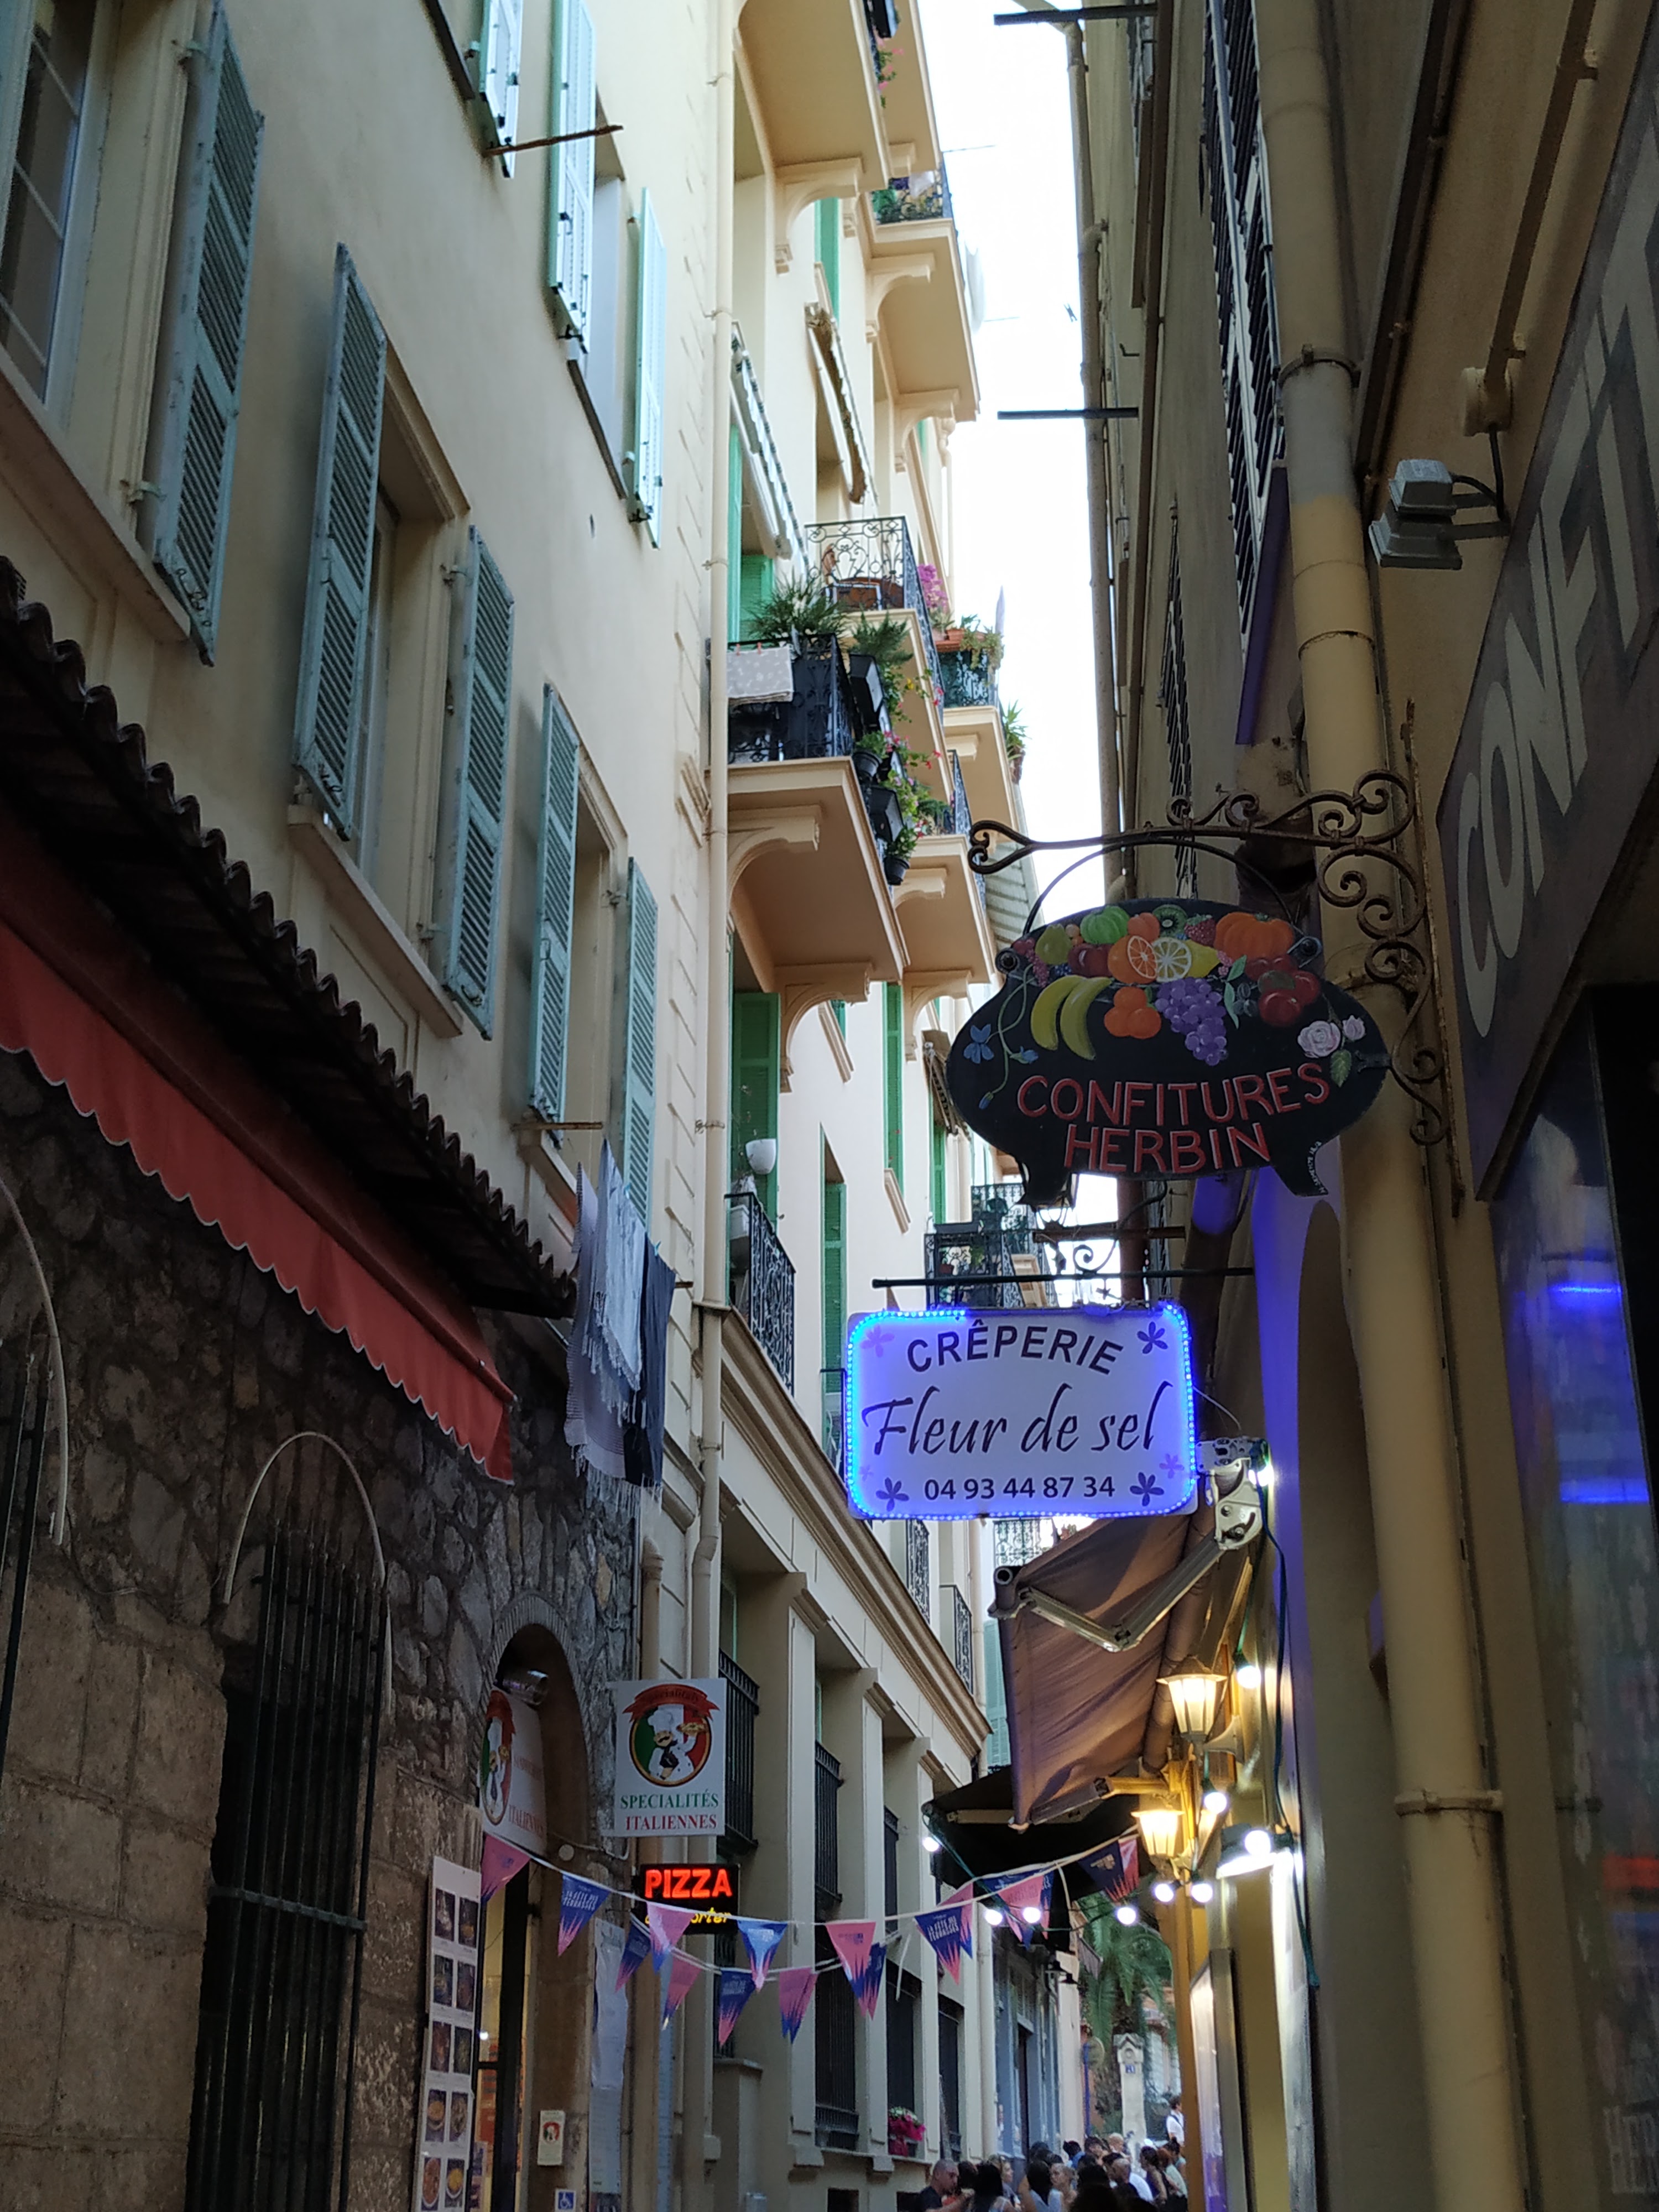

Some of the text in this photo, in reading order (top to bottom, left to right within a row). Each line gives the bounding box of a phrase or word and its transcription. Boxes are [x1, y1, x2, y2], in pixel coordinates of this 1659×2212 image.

[1017, 1062, 1330, 1126] CONFITURES
[1063, 1122, 1271, 1173] HERBIN
[907, 1319, 1124, 1375] CRÊPERIE
[861, 1380, 1173, 1455] Fleur de sel
[924, 1475, 1116, 1500] 04 93 44 87 34
[620, 1788, 719, 1809] SPECIALITÉS
[625, 1813, 717, 1831] ITALIENNES
[644, 1868, 733, 1899] PIZZA
